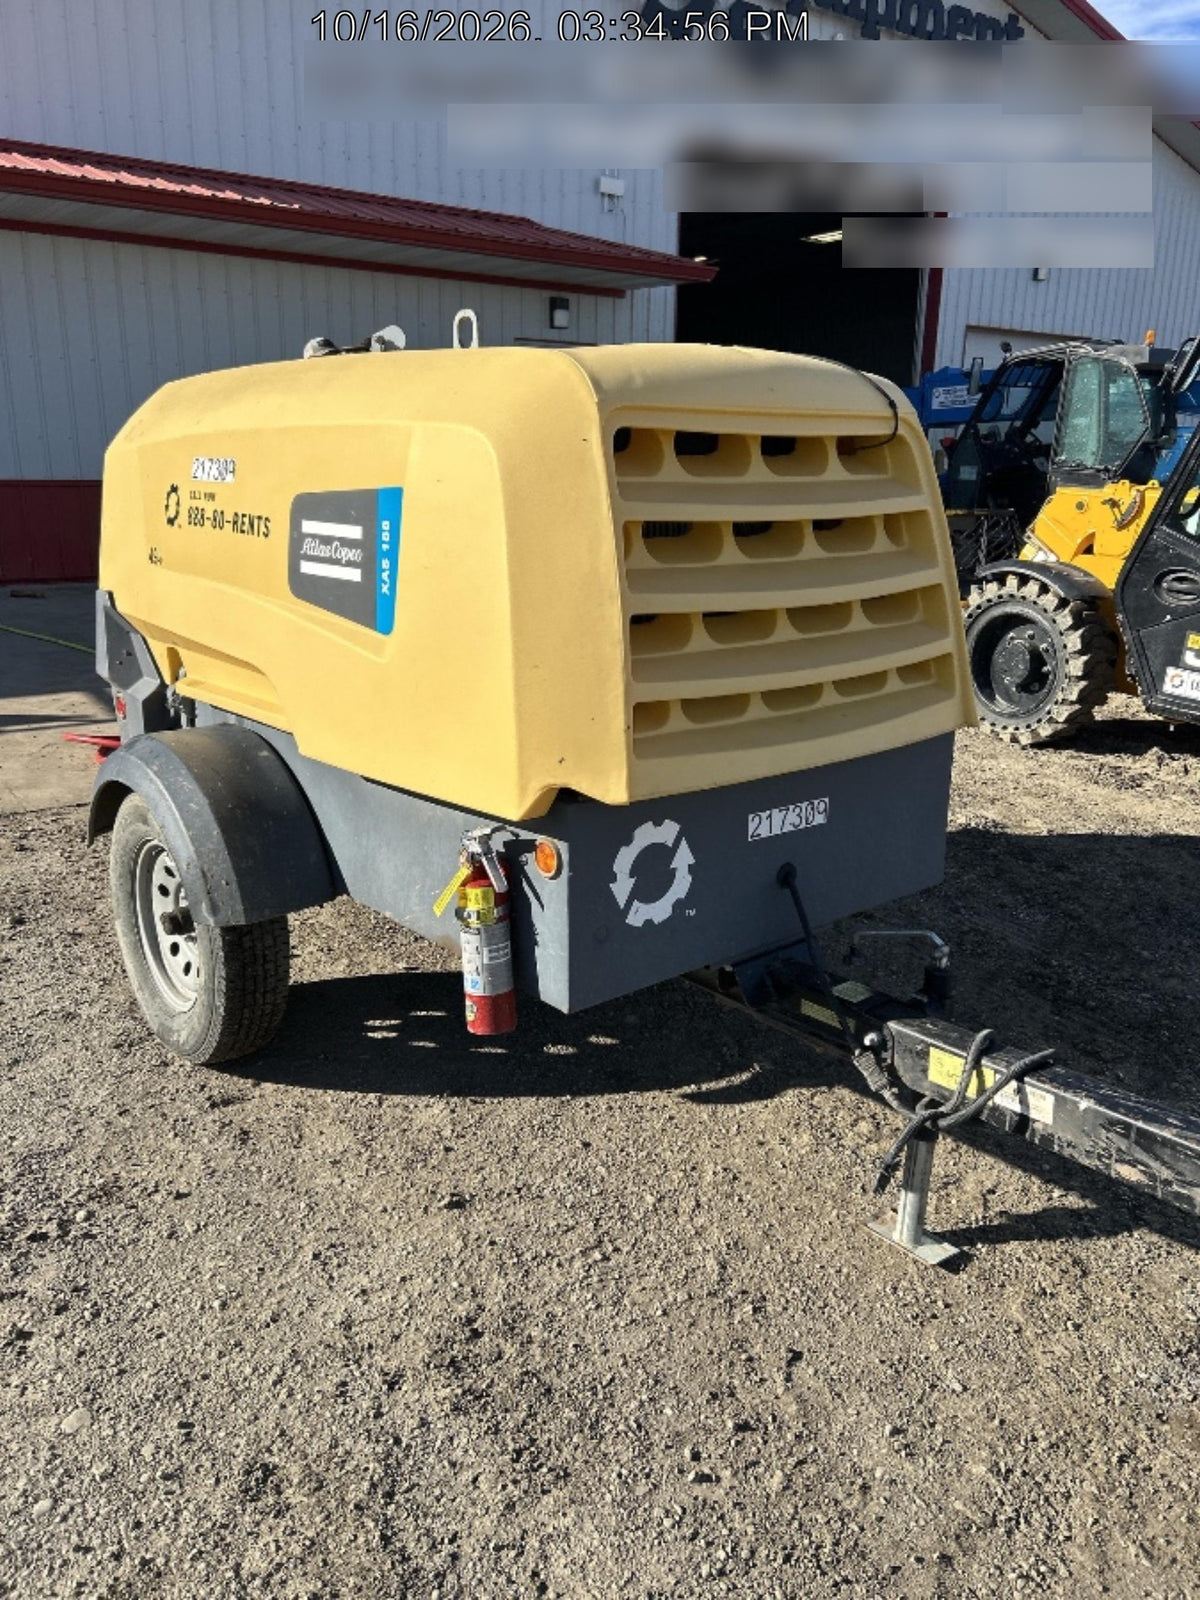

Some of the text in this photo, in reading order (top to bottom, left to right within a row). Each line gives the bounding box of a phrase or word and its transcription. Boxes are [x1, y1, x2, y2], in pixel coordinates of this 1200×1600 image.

[300, 537, 363, 564] Atlas Copco
[750, 798, 828, 840] 217309
